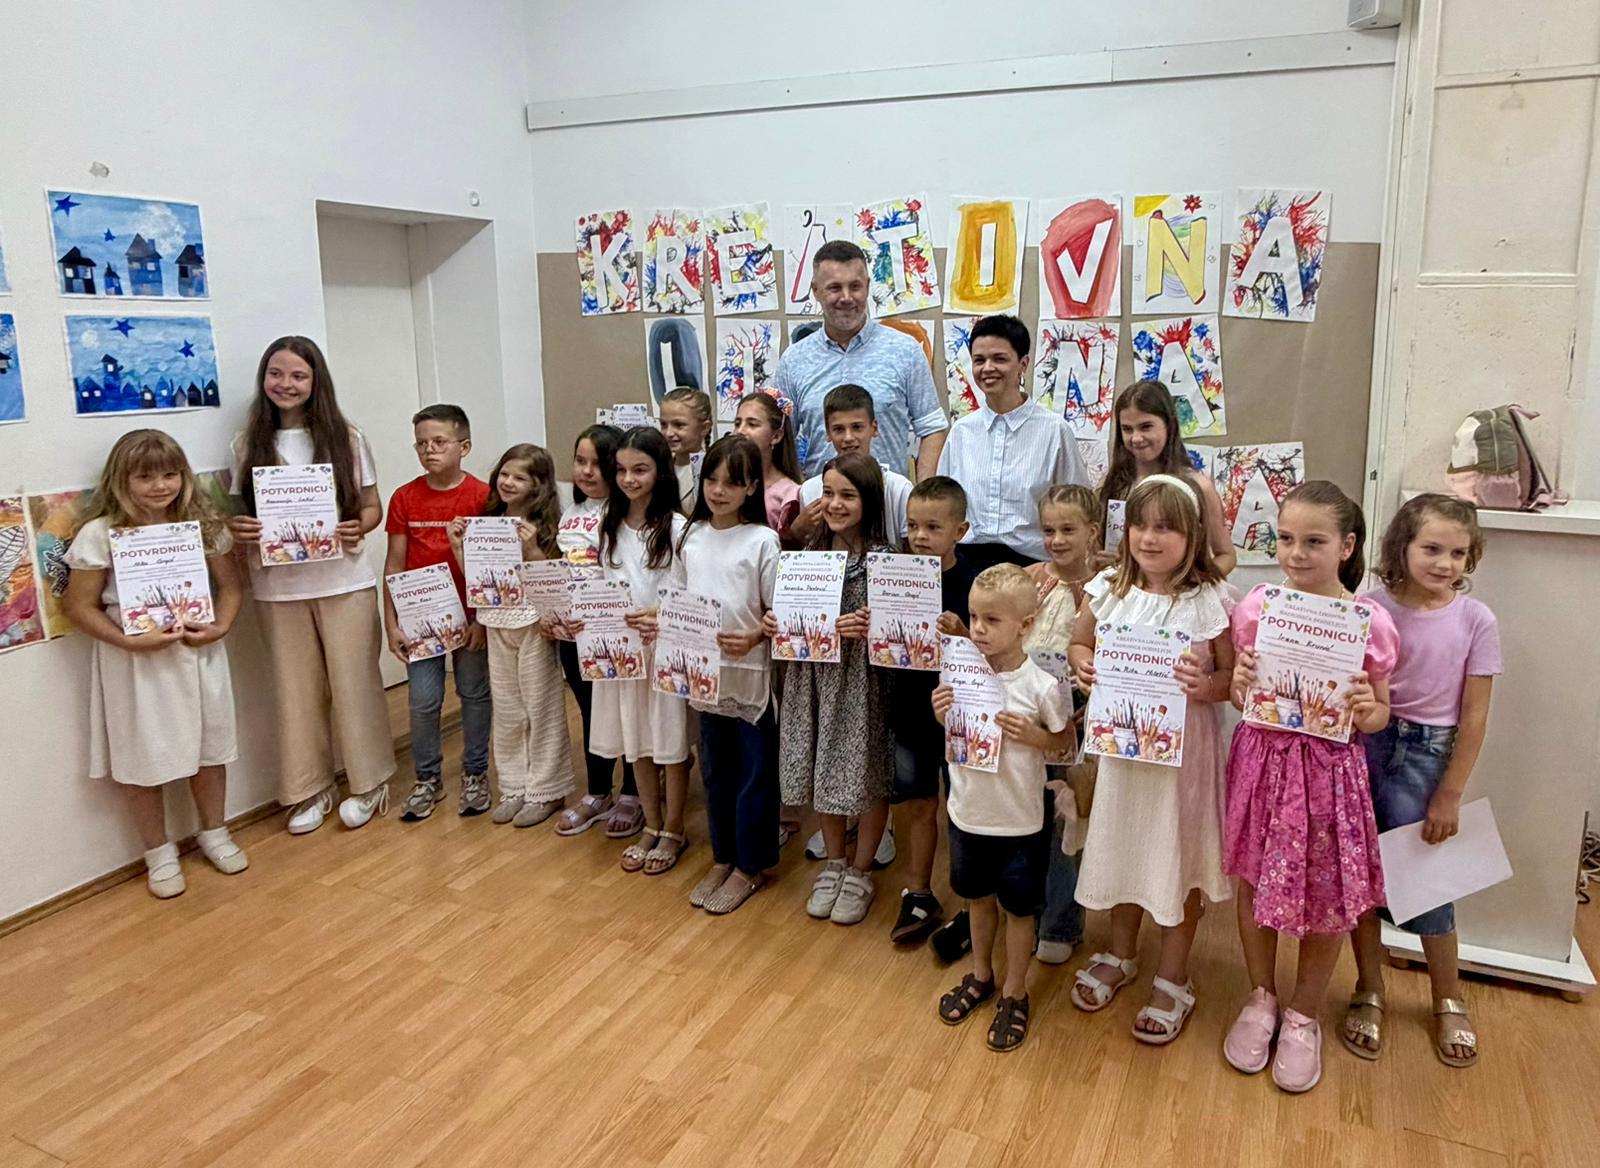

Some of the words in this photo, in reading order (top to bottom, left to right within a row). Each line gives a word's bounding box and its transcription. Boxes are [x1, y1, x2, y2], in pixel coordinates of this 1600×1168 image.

[261, 485, 328, 496] POTVRDNICU
[468, 536, 517, 544] POTVRDNICU
[119, 543, 196, 559] POTVRDNICU
[780, 573, 839, 583] POTVRDNICU
[872, 577, 936, 590] POTVRDNICU
[396, 582, 450, 600] POTVRDNICU
[575, 601, 630, 611] POTVRDNICU
[661, 609, 717, 629] POTVRDNICU
[1267, 616, 1358, 644] POTVRDNICU
